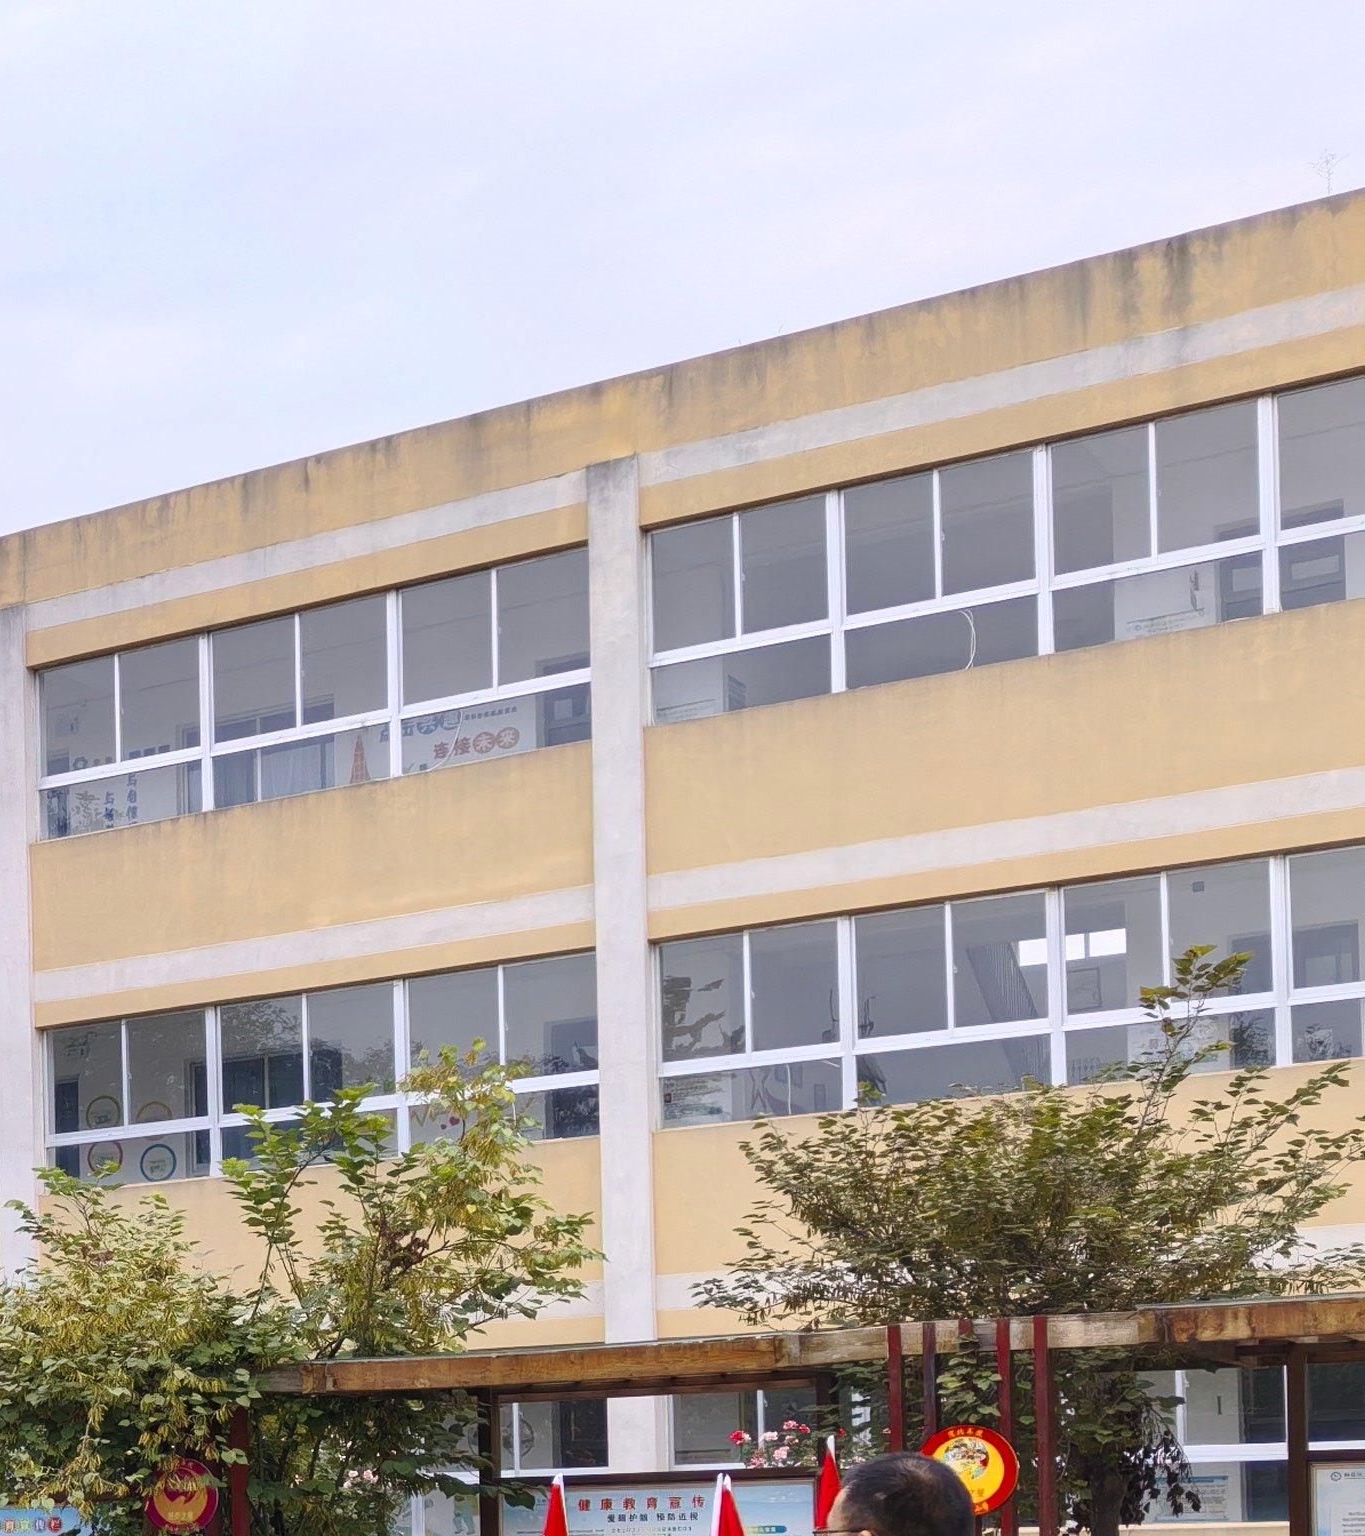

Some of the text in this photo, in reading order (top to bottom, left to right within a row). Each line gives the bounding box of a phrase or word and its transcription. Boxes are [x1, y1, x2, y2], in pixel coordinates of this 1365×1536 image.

[577, 1494, 706, 1512] 健康教育宣传
